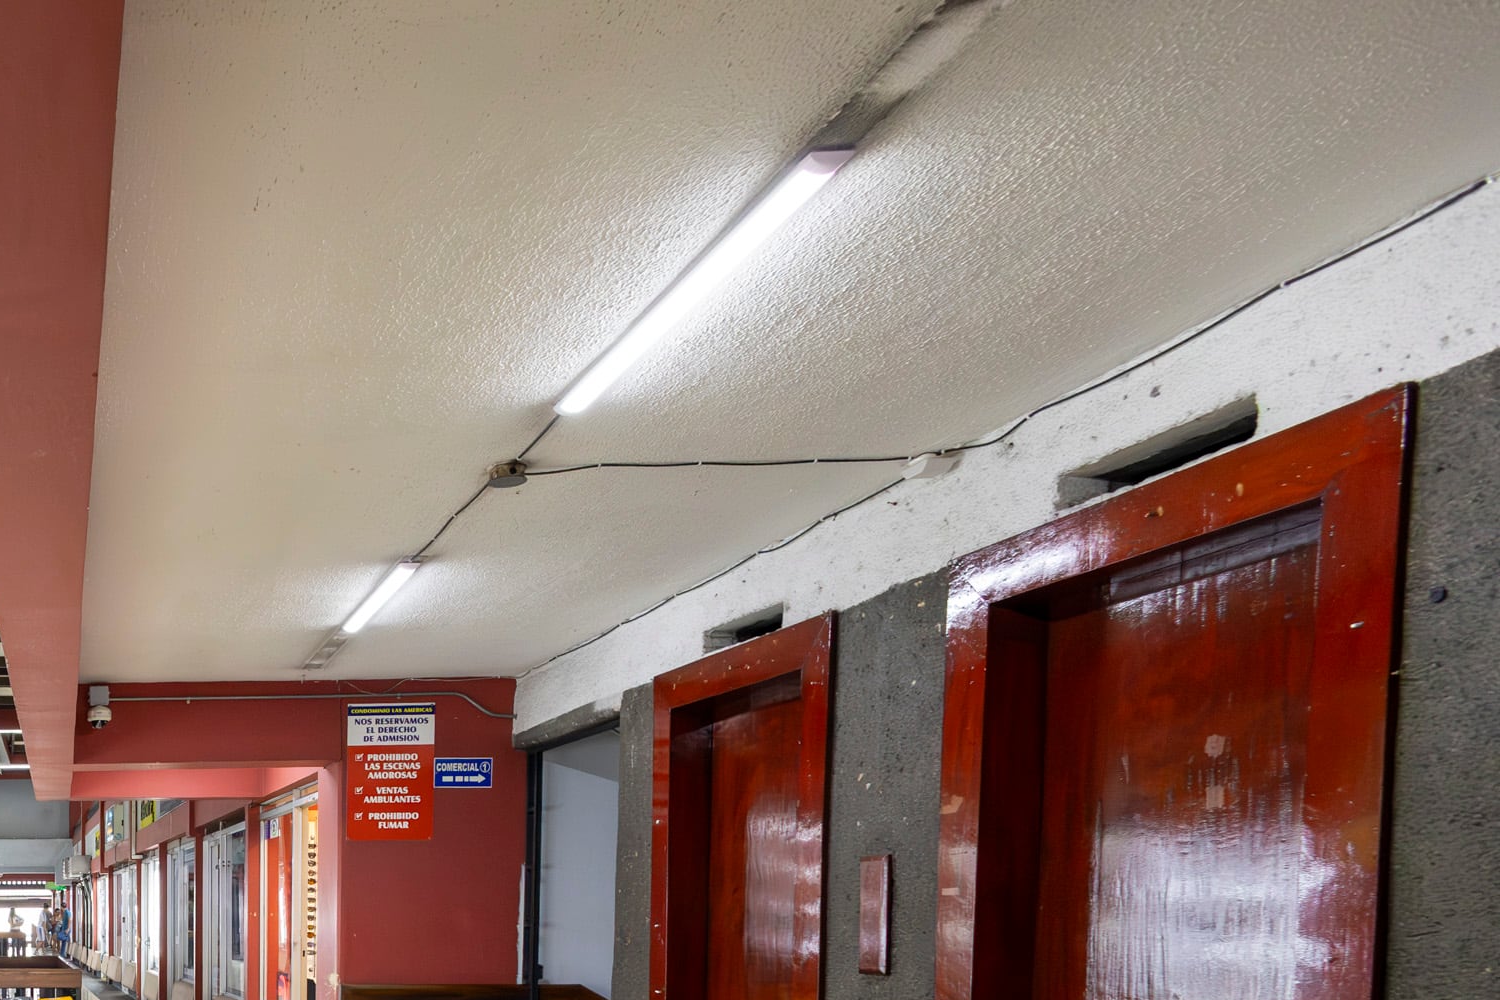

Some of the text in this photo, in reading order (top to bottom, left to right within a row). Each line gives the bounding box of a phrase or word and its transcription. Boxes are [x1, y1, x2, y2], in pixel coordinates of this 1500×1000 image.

[374, 717, 429, 725] RESERVAMOS
[366, 726, 417, 734] EL DERECHO
[363, 734, 420, 743] DE ADMISION
[367, 753, 418, 761] PROHIBIDO
[364, 762, 421, 771] LAS ESCENAS
[436, 762, 480, 772] COMERCIAL
[367, 771, 418, 780] AMOROSAS
[376, 786, 409, 795] VENTAS
[363, 795, 422, 804] AMBULANTES
[368, 812, 420, 821] PROHIBIDO
[378, 821, 409, 829] FUMAR
